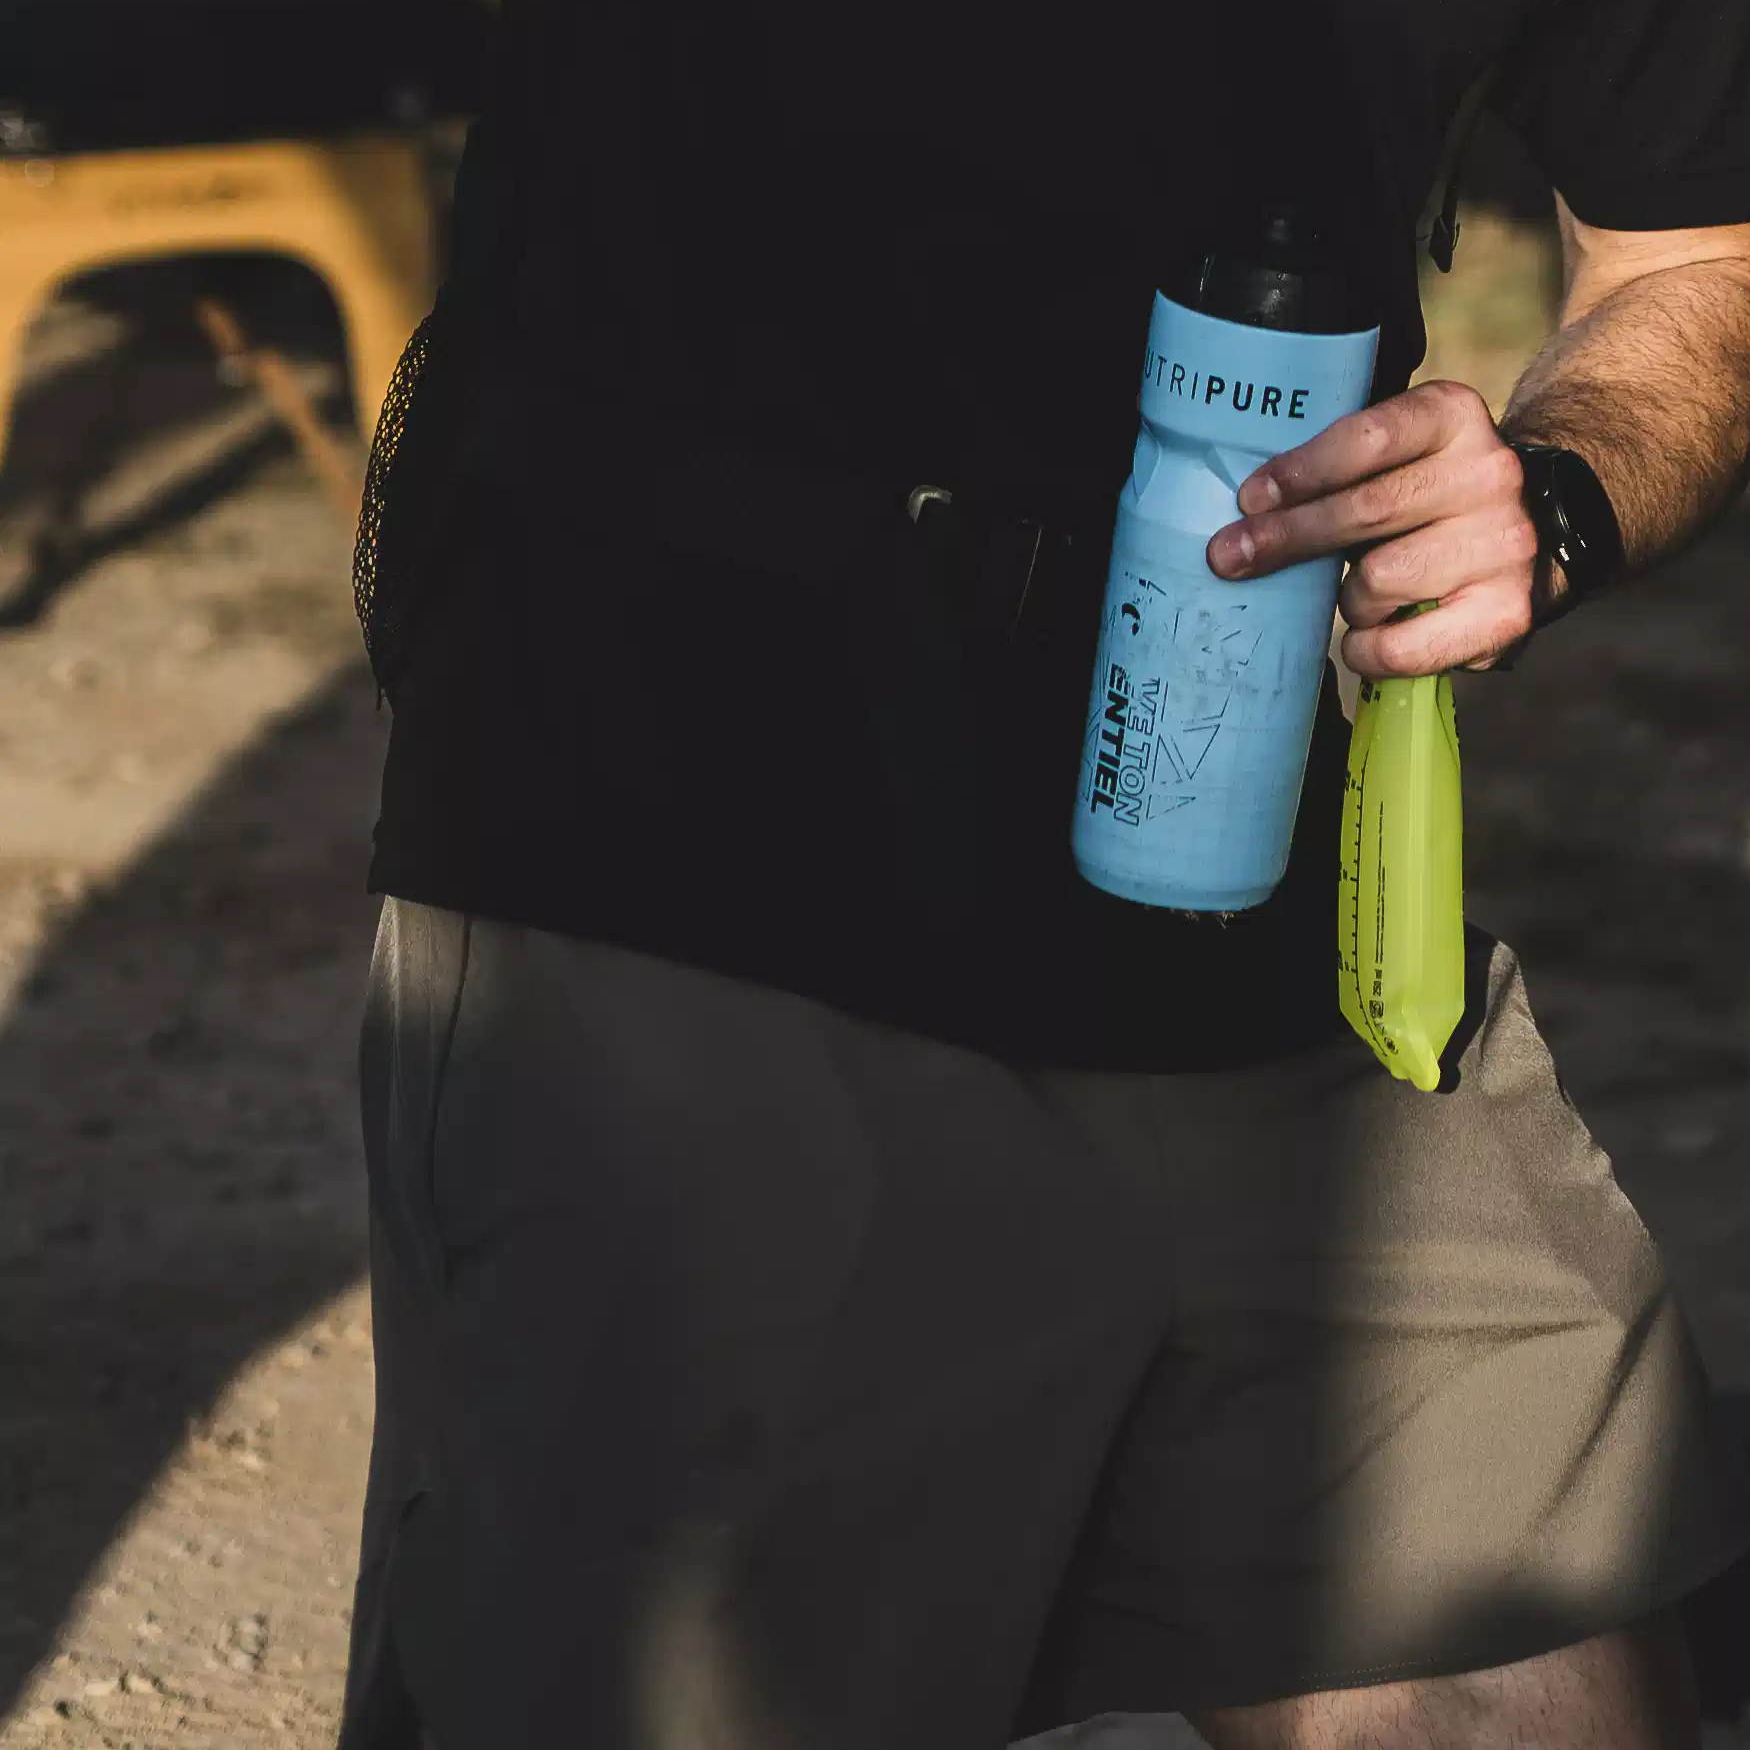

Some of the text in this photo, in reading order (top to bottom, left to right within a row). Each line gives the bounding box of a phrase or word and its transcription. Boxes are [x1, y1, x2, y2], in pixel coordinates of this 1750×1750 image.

[1143, 350, 1310, 419] UTRIPURE
[1090, 604, 1141, 814] ENTIEL
[1113, 740, 1151, 827] TON
